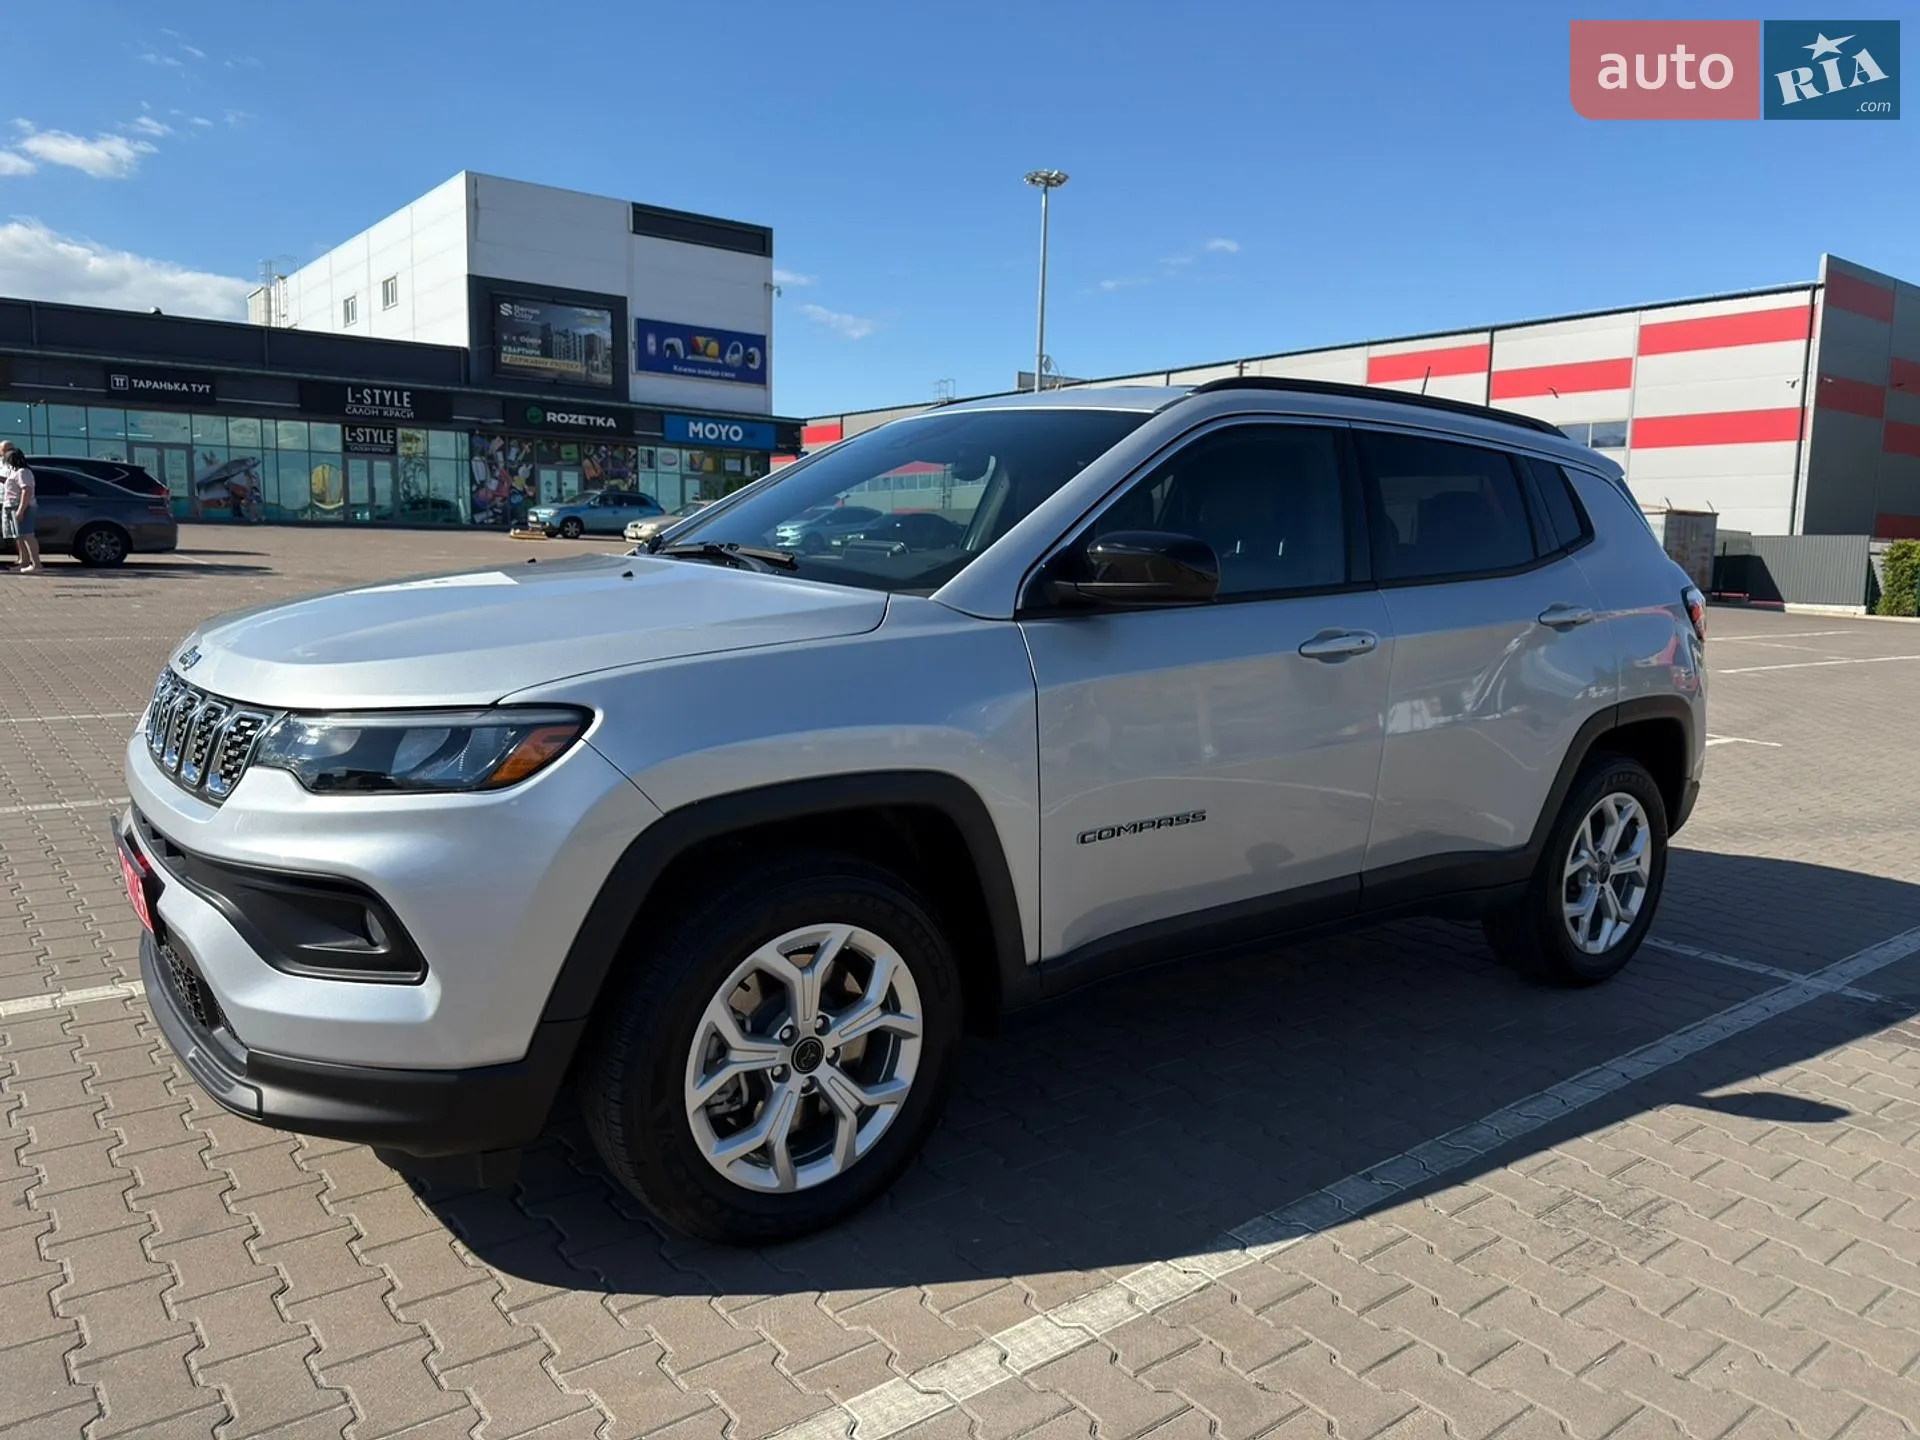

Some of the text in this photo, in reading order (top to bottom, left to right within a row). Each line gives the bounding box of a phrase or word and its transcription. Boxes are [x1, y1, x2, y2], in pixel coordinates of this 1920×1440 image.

[132, 378, 211, 394] ТАРАНЬКА ТУТ
[347, 386, 412, 408] L-STYLE
[345, 406, 415, 419] САЛОН КРАСИ
[546, 411, 617, 428] ROZETKA
[345, 426, 394, 444] L-STYLE
[688, 420, 744, 442] MOYO
[1076, 808, 1208, 846] COMPASS
